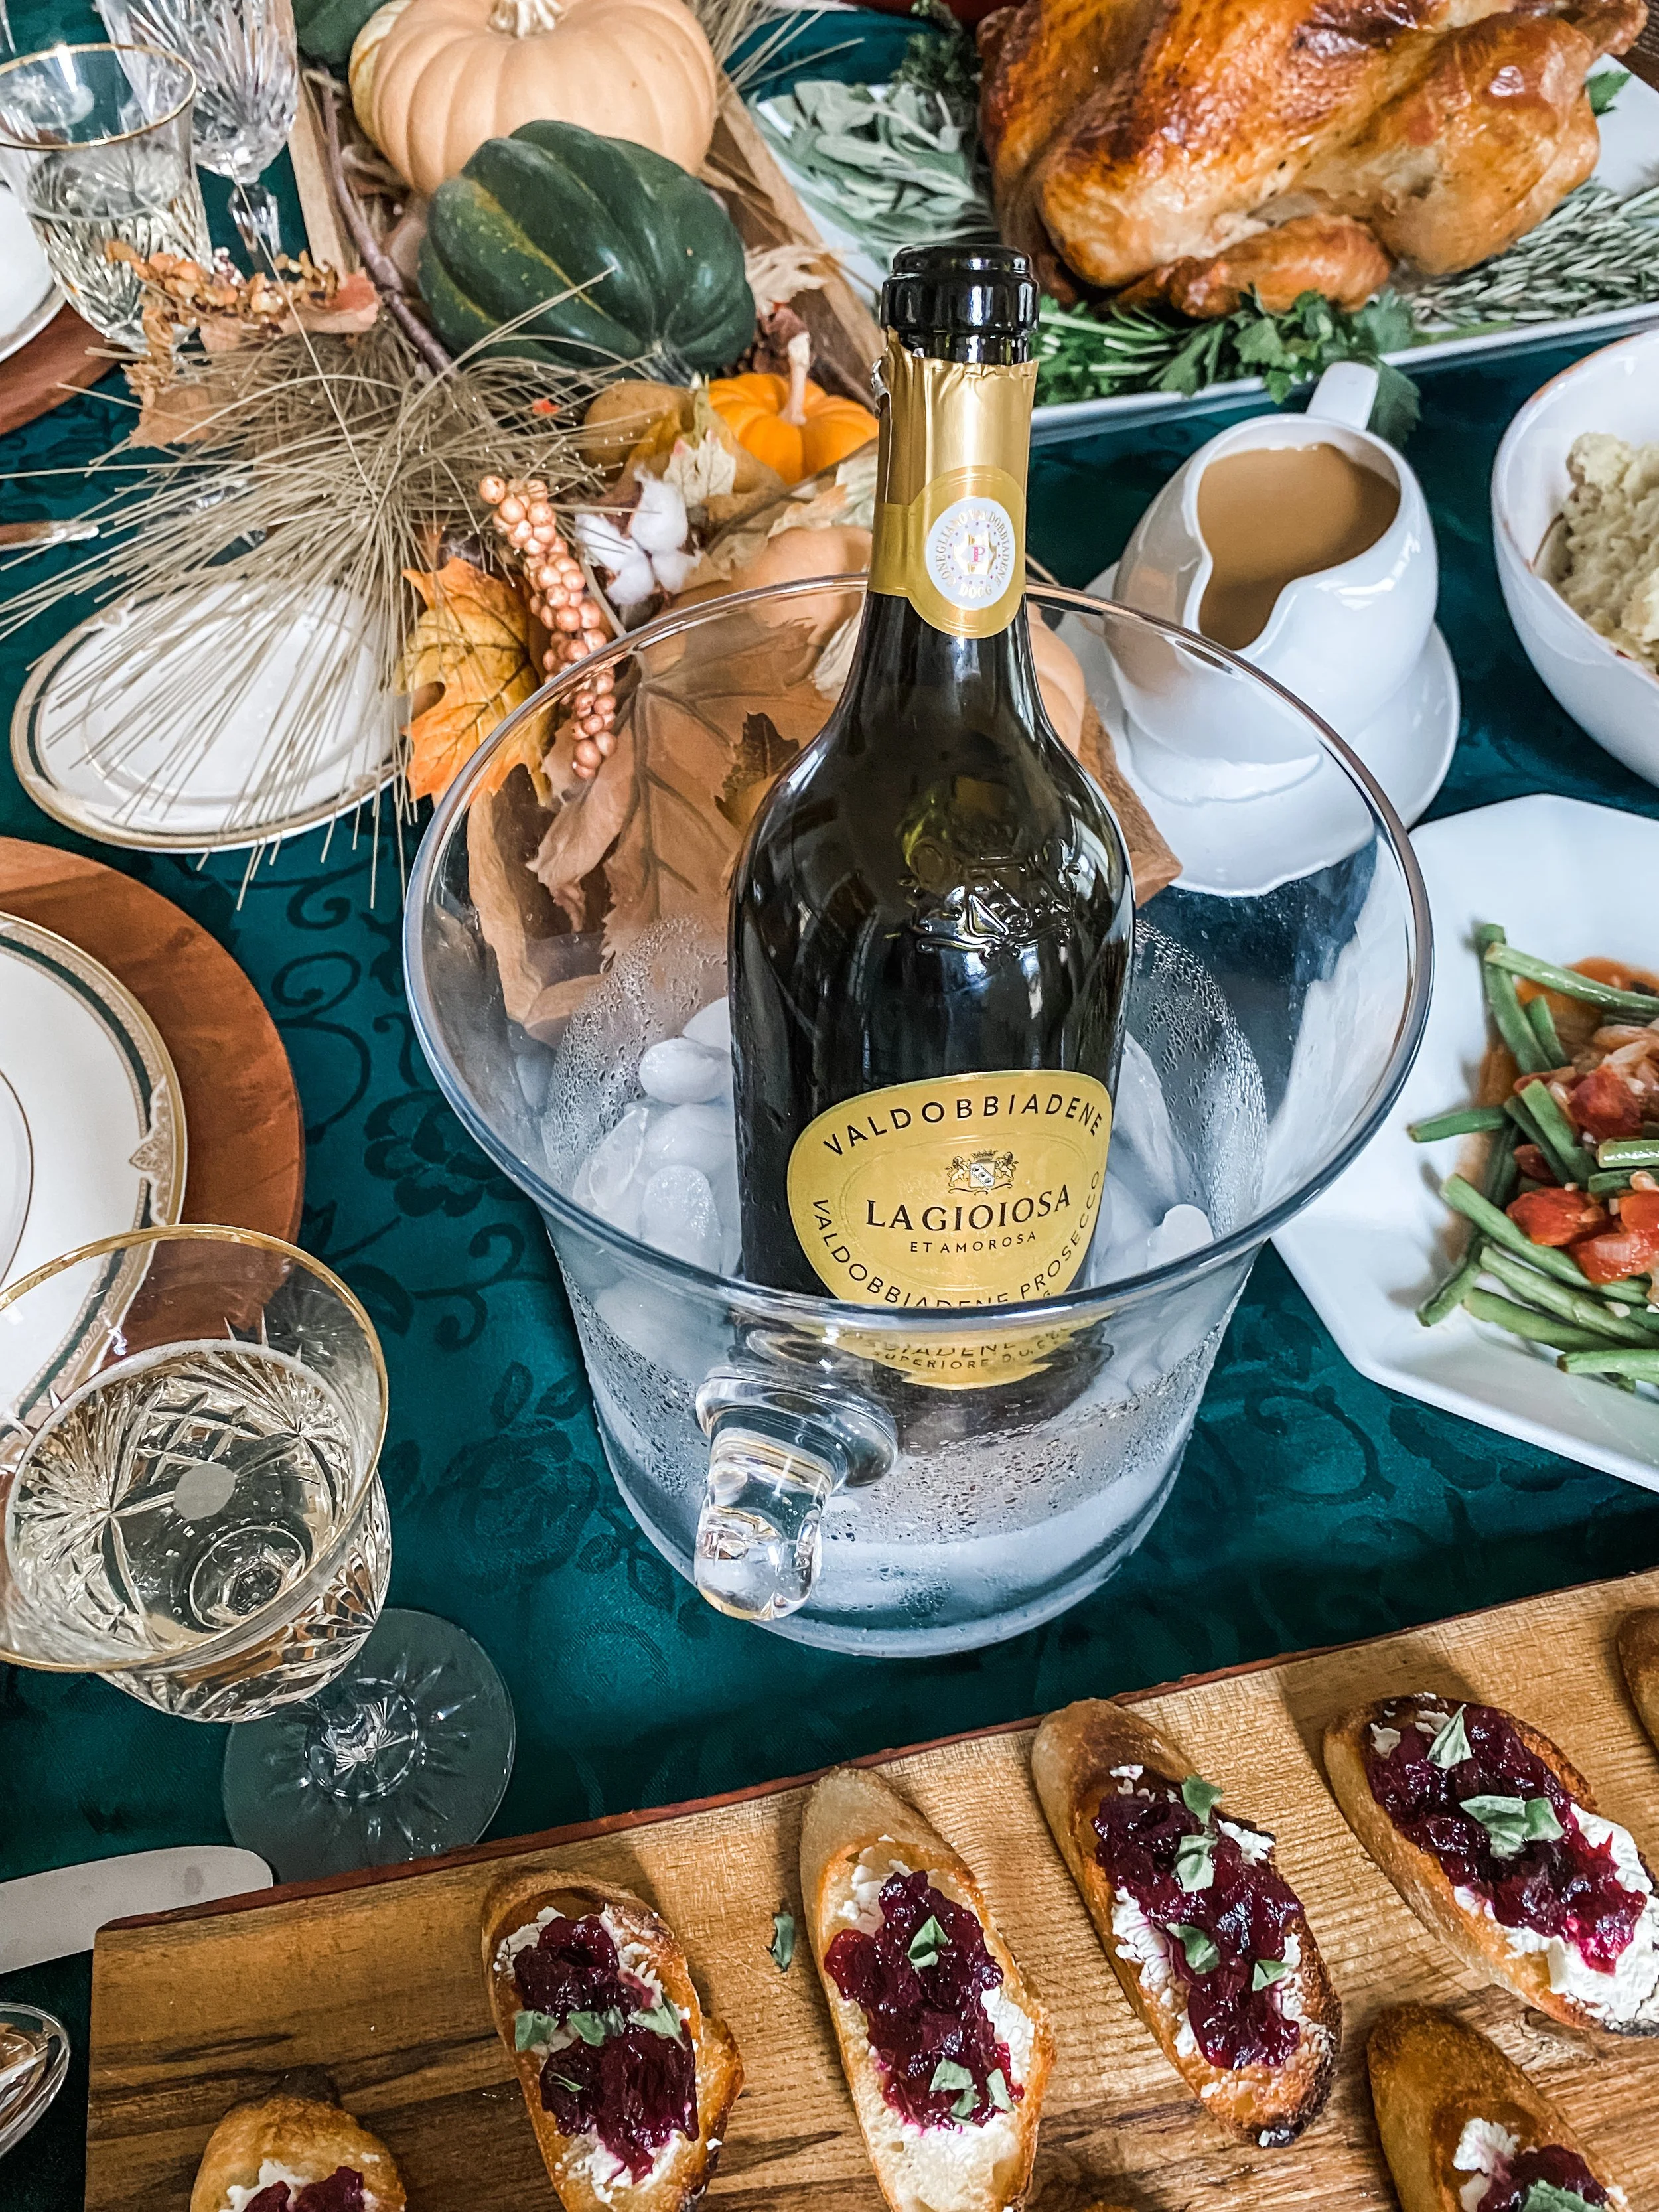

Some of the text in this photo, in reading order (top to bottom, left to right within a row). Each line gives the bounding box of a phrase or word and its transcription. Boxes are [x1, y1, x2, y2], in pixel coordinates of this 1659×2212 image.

[972, 546, 985, 562] P
[960, 584, 992, 598] DOCG
[823, 1094, 1102, 1155] VALDOBBIADENE
[1021, 1171, 1100, 1301] PROSECCO
